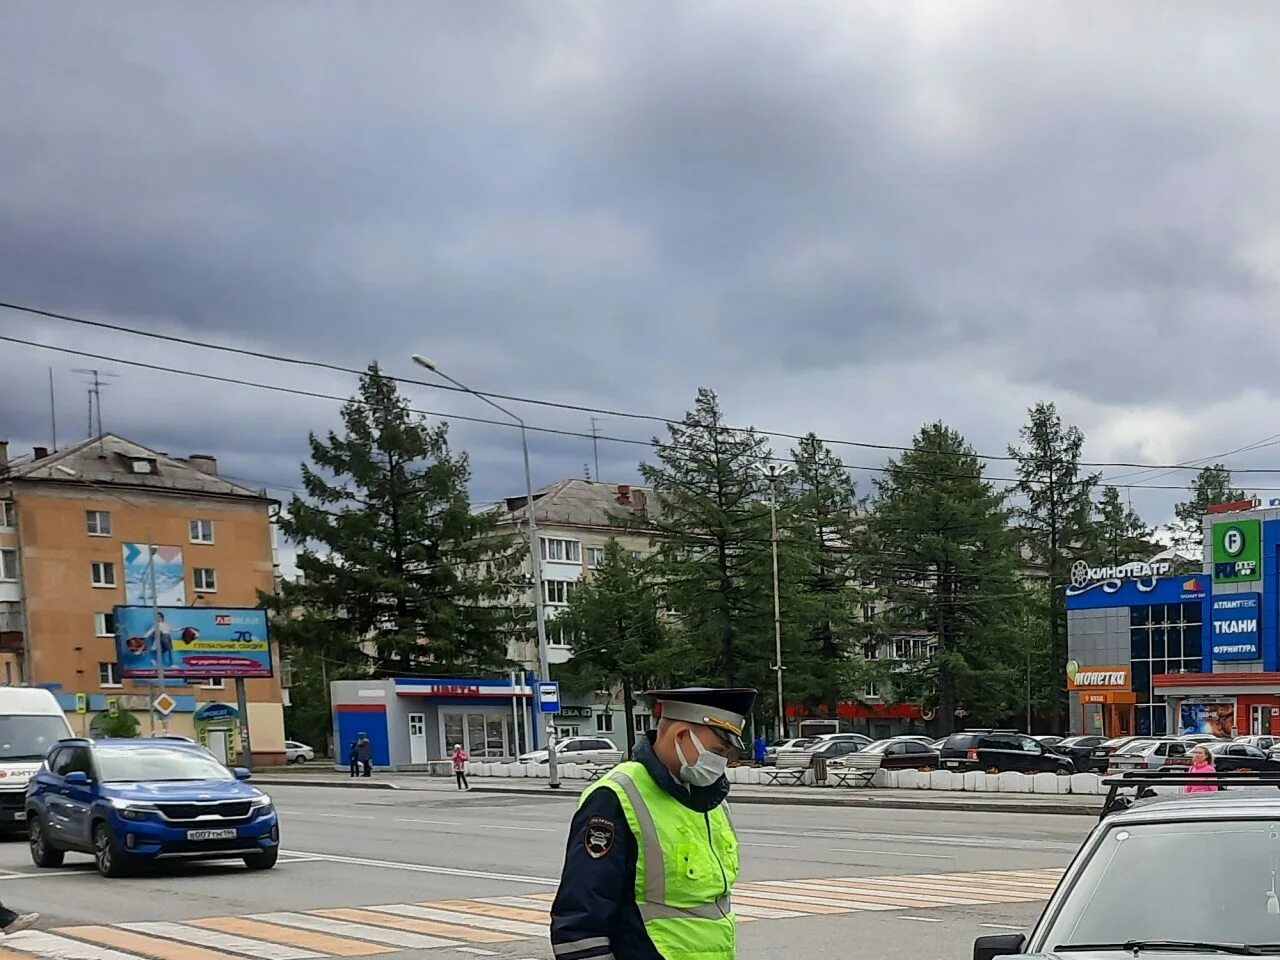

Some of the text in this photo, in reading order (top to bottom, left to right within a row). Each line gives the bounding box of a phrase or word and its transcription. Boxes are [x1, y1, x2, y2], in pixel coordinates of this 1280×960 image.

[1087, 563, 1171, 580] КИНОТЕАТР
[1213, 619, 1257, 634] ТКАНИ
[1213, 644, 1257, 654] ФУРНИТУРА
